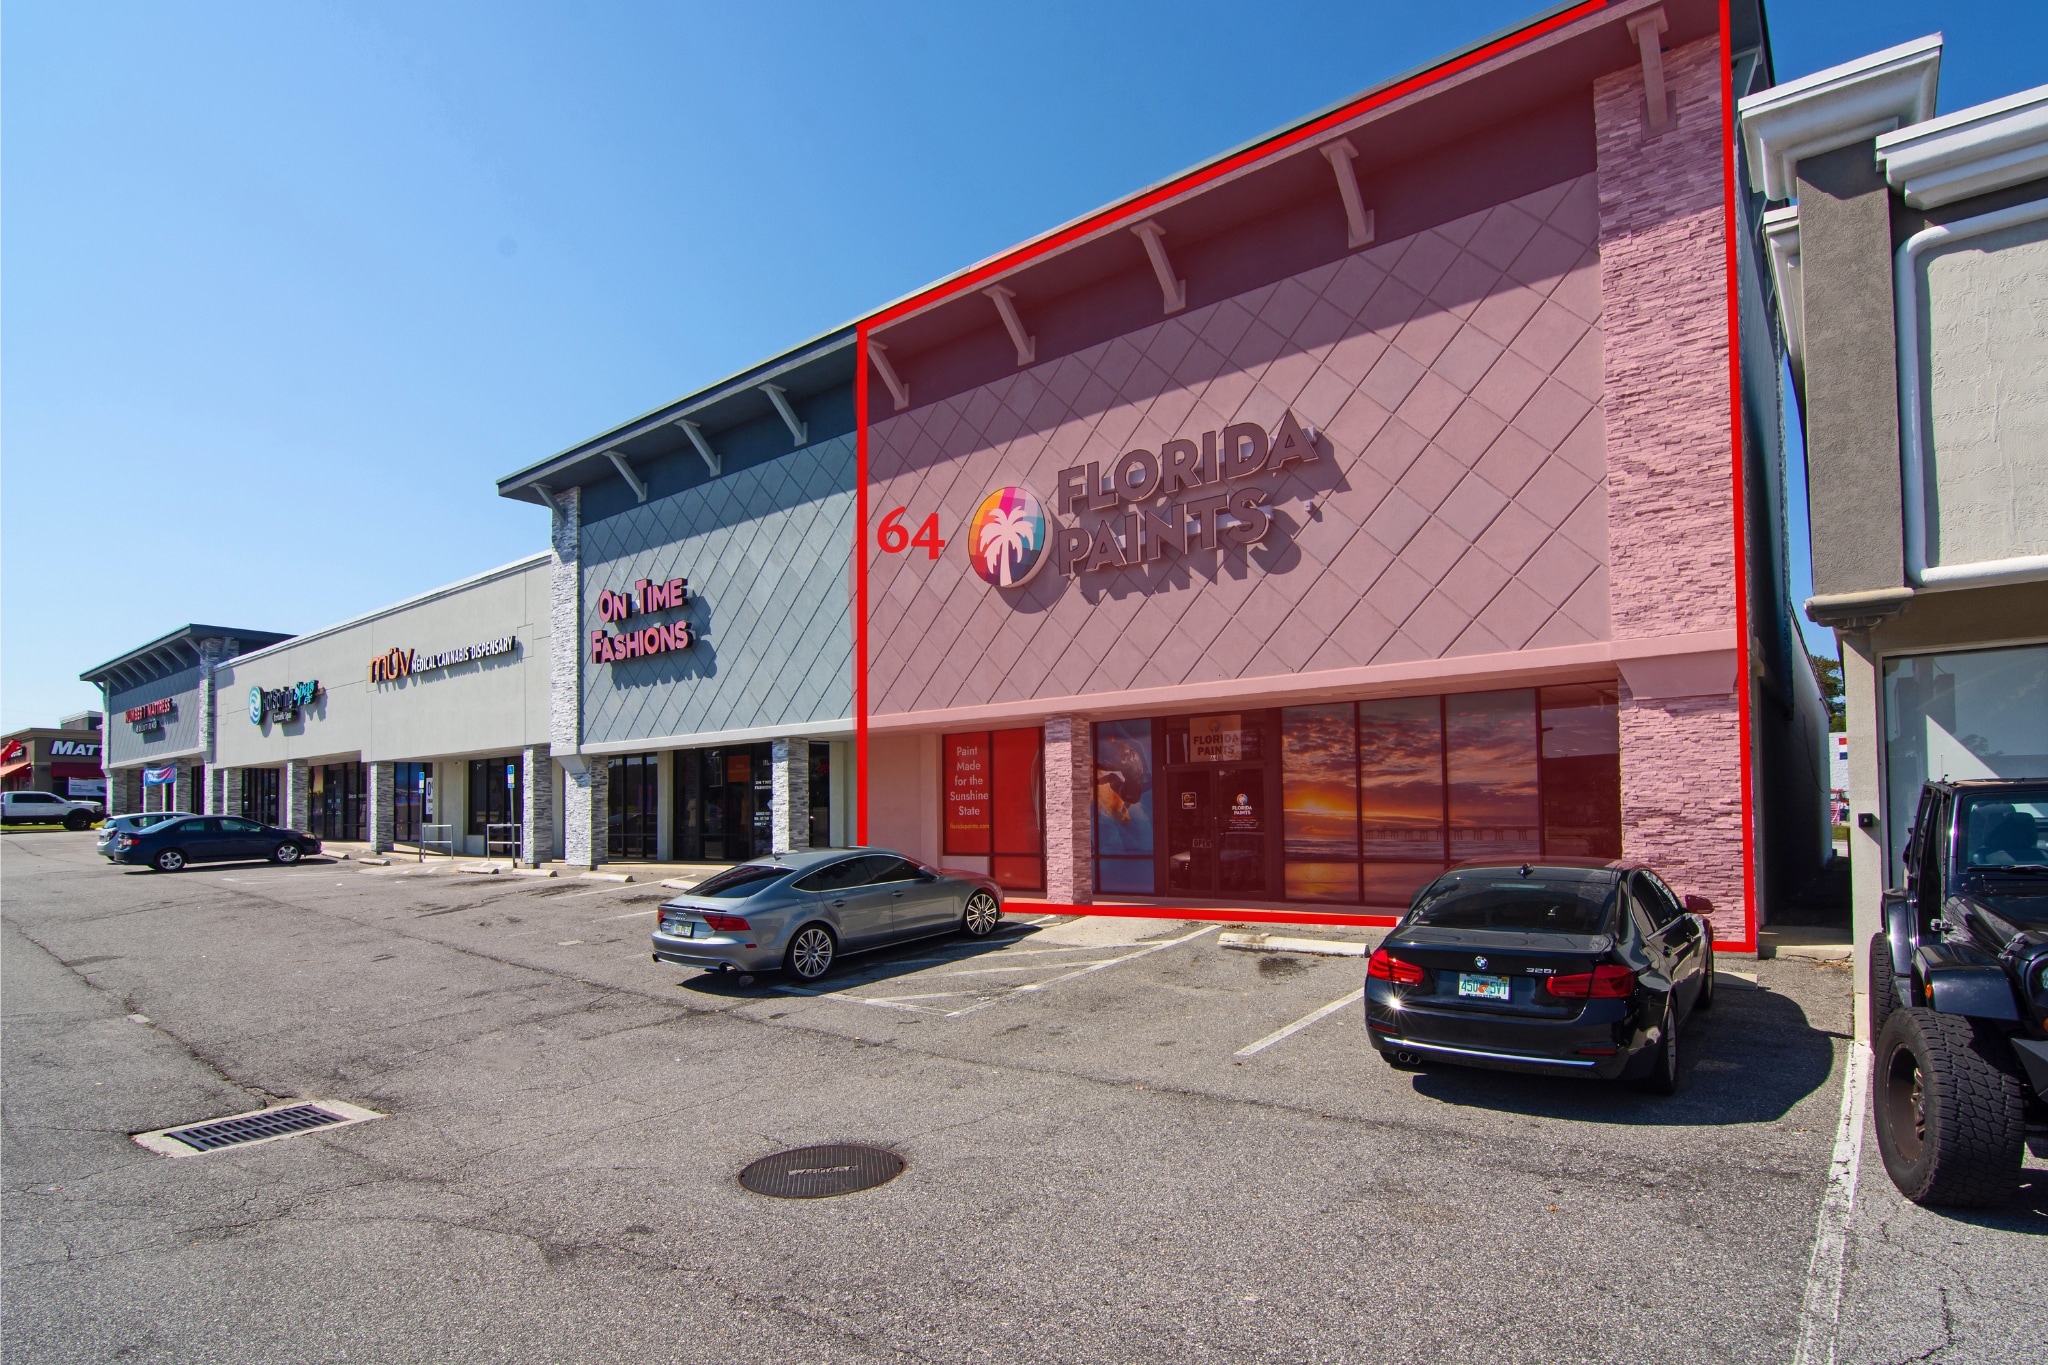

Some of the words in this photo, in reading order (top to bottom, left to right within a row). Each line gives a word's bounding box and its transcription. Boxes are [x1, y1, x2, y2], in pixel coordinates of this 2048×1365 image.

[1057, 409, 1318, 516] FLORIDA
[1057, 487, 1269, 577] PAINTS
[598, 589, 631, 622] ON
[635, 578, 687, 614] TIME
[591, 620, 691, 664] FASHIONS
[411, 655, 436, 674] MEDICAL
[438, 647, 469, 668] CANNABIS
[471, 637, 514, 660] DISPENSARY
[1193, 734, 1238, 745] FLORIDA
[956, 746, 978, 757] Paint
[1197, 745, 1235, 756] PAINTS
[956, 760, 981, 771] Made
[954, 775, 967, 786] for
[969, 775, 983, 786] the
[950, 789, 989, 801] Sunshine
[958, 805, 980, 816] State
